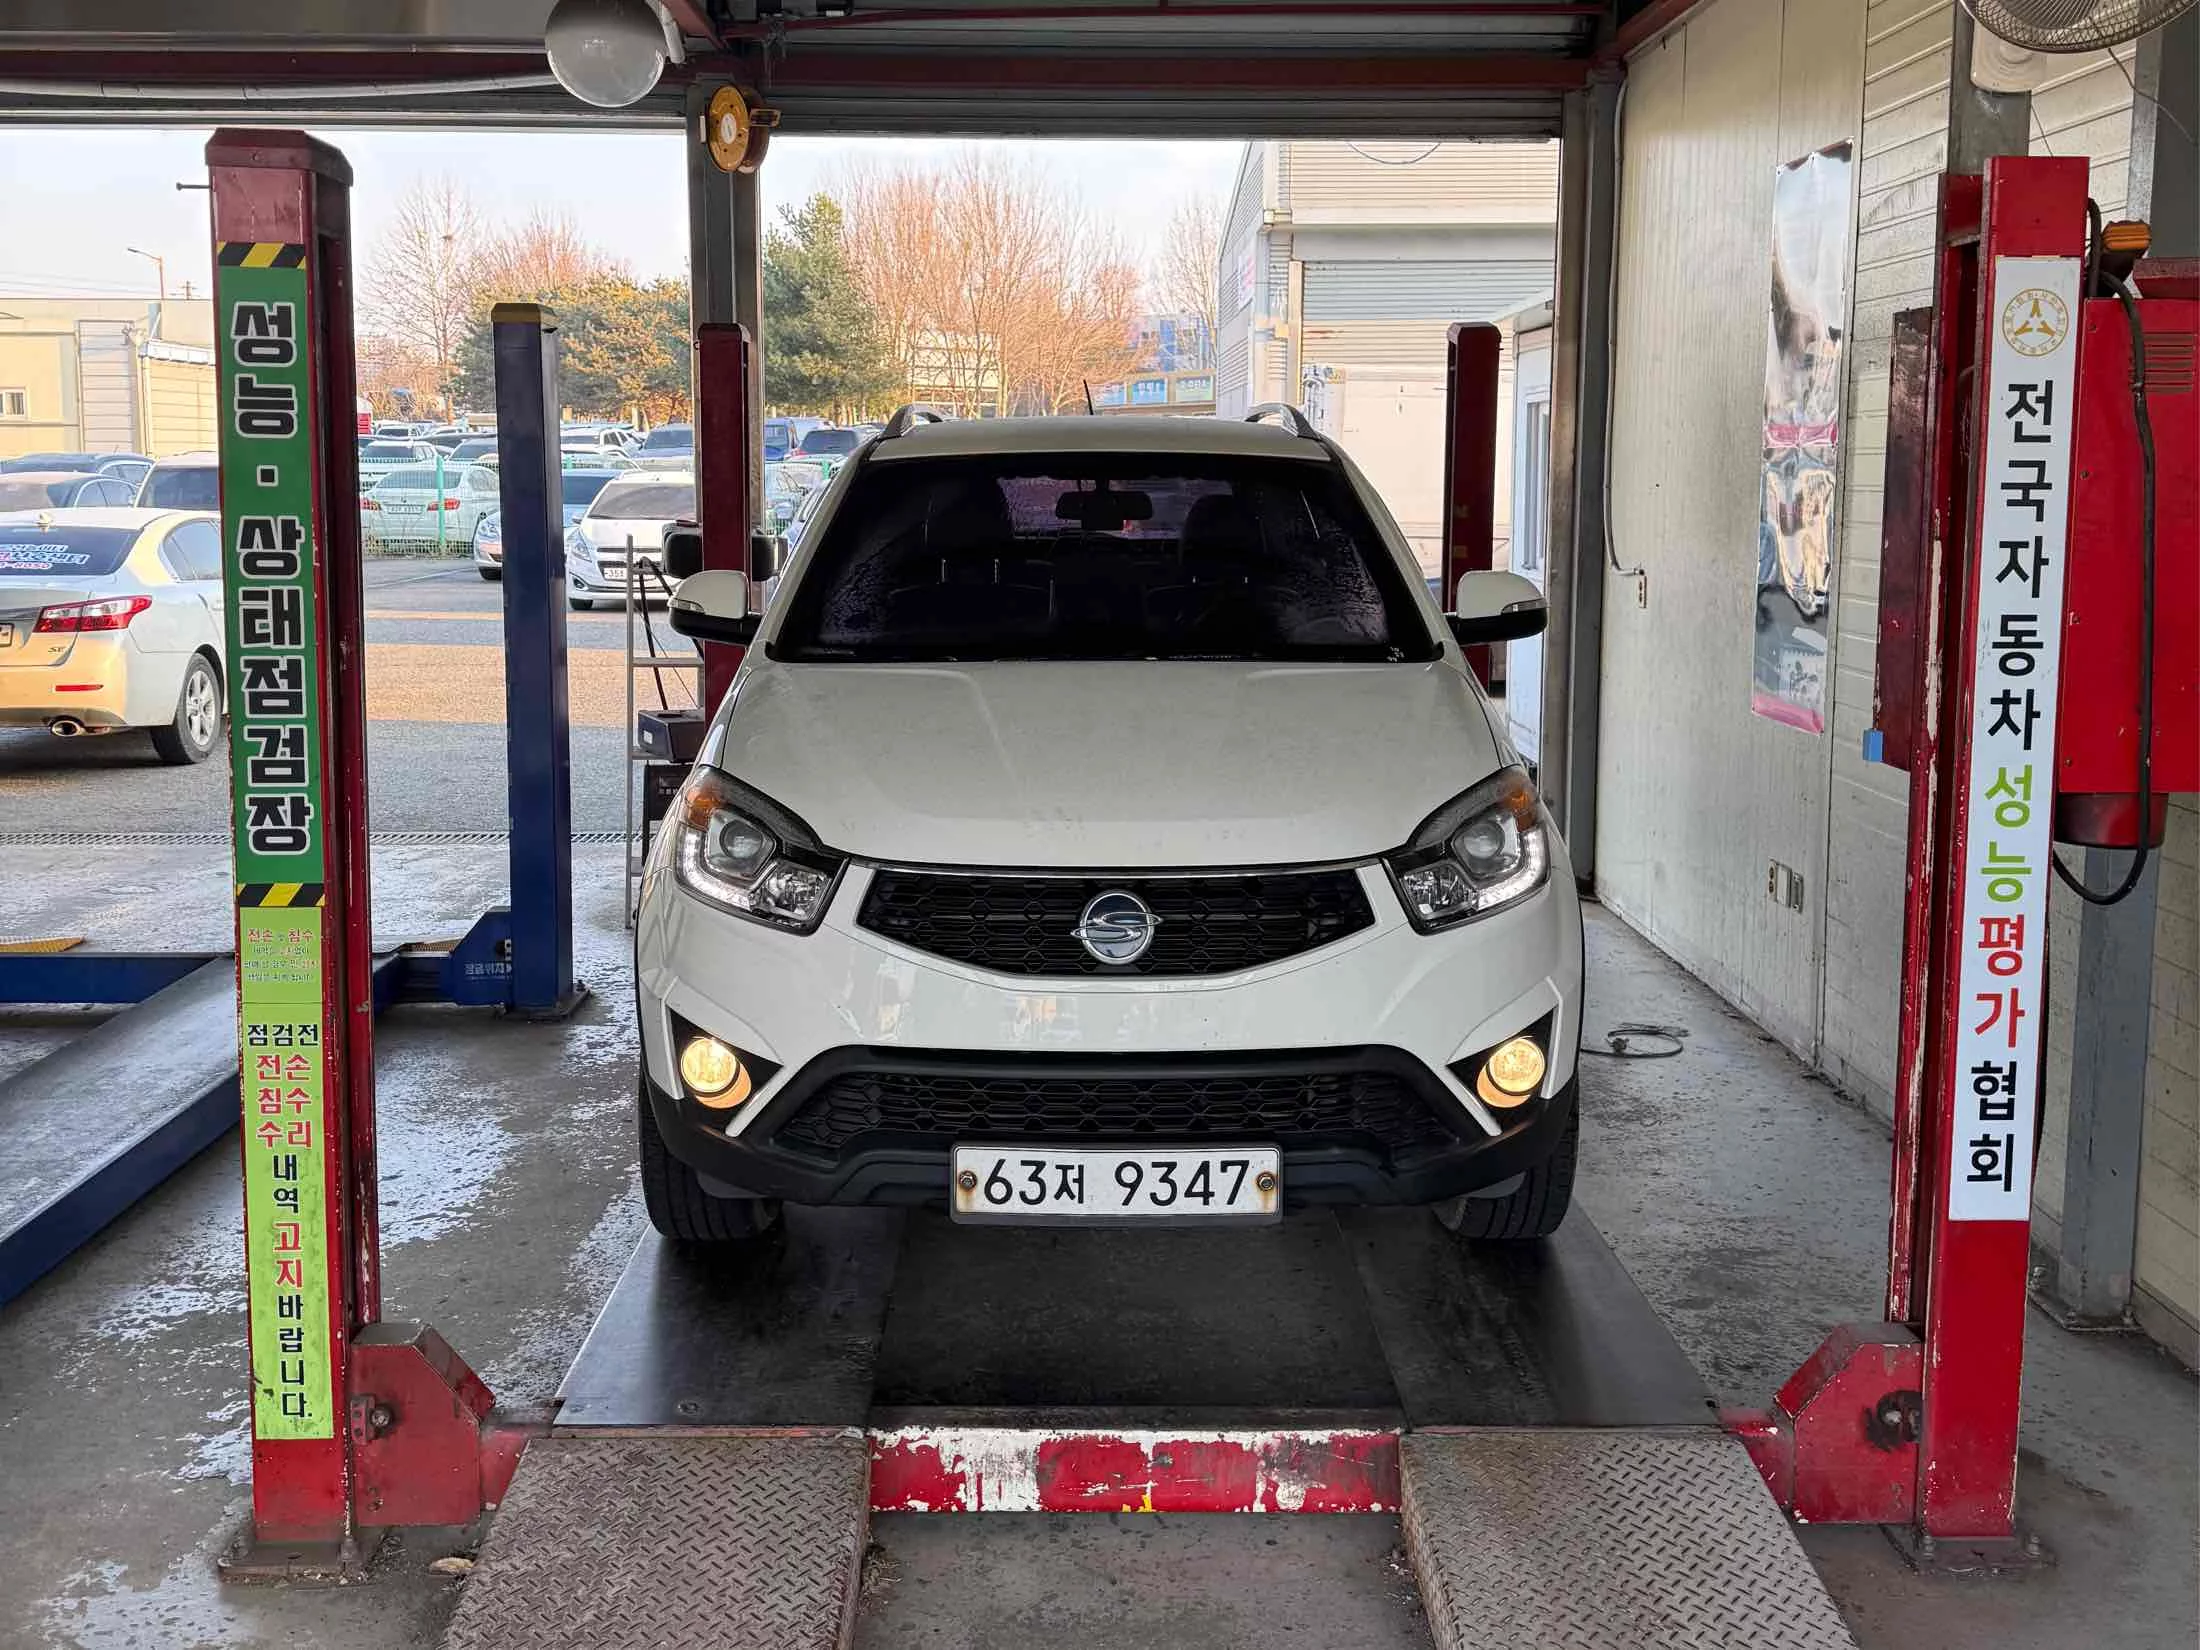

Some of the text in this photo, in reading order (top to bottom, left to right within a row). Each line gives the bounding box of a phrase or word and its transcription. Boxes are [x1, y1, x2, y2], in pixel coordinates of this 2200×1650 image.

[248, 1024, 318, 1046] 점검전
[256, 1054, 311, 1081] 전손
[258, 1087, 312, 1115] 침수
[257, 1120, 312, 1148] 수리
[984, 1158, 1250, 1207] 63저 9347
